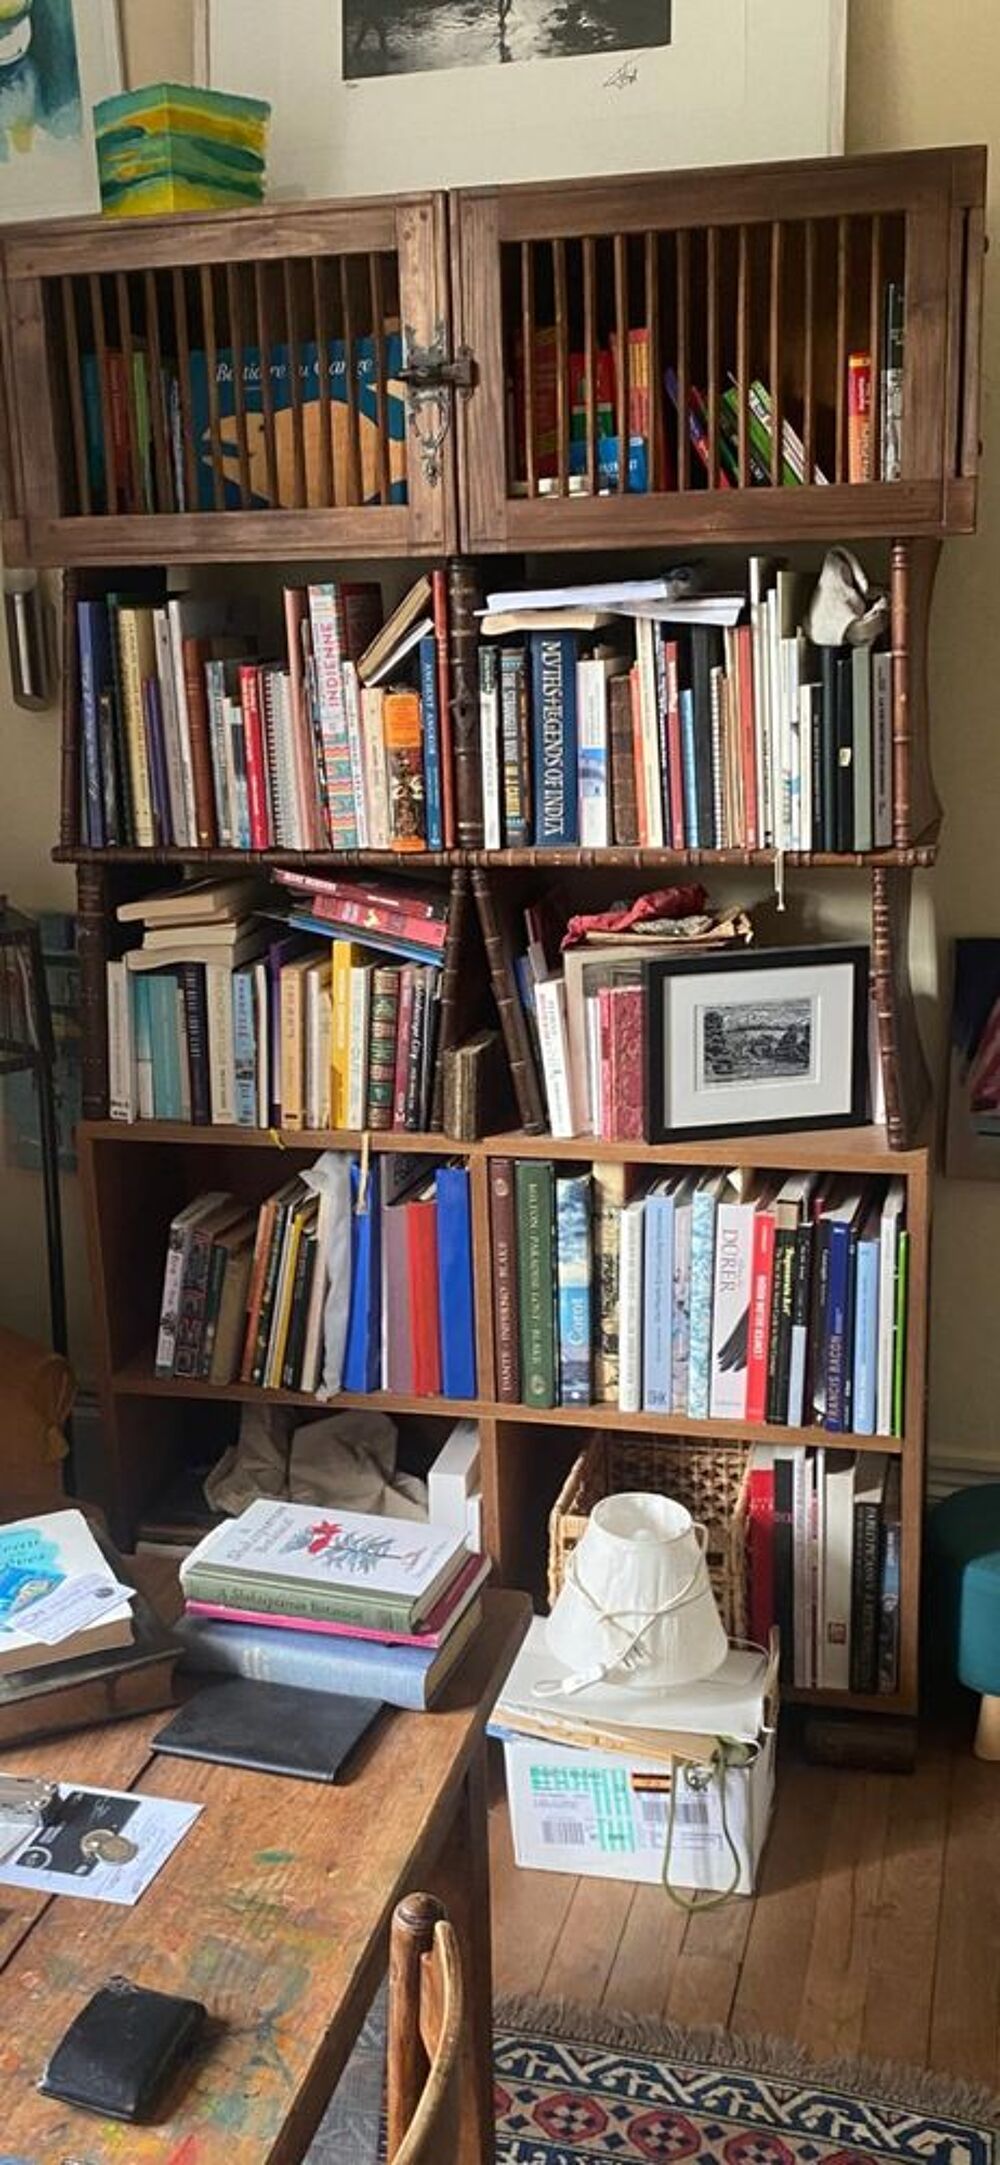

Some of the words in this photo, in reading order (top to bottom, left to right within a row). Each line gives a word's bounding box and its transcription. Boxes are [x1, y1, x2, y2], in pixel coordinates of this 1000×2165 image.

[216, 362, 286, 382] Betiare
[321, 622, 340, 707] INDIENNE
[426, 712, 437, 756] ANGKOR
[543, 790, 563, 836] INDIA
[530, 1234, 540, 1291] PARADISE
[500, 1285, 510, 1341] INFERNO
[568, 1297, 585, 1345] Corot
[501, 1352, 511, 1391] DANTE
[829, 1334, 841, 1374] BACON
[827, 1375, 840, 1422] FRANCIS
